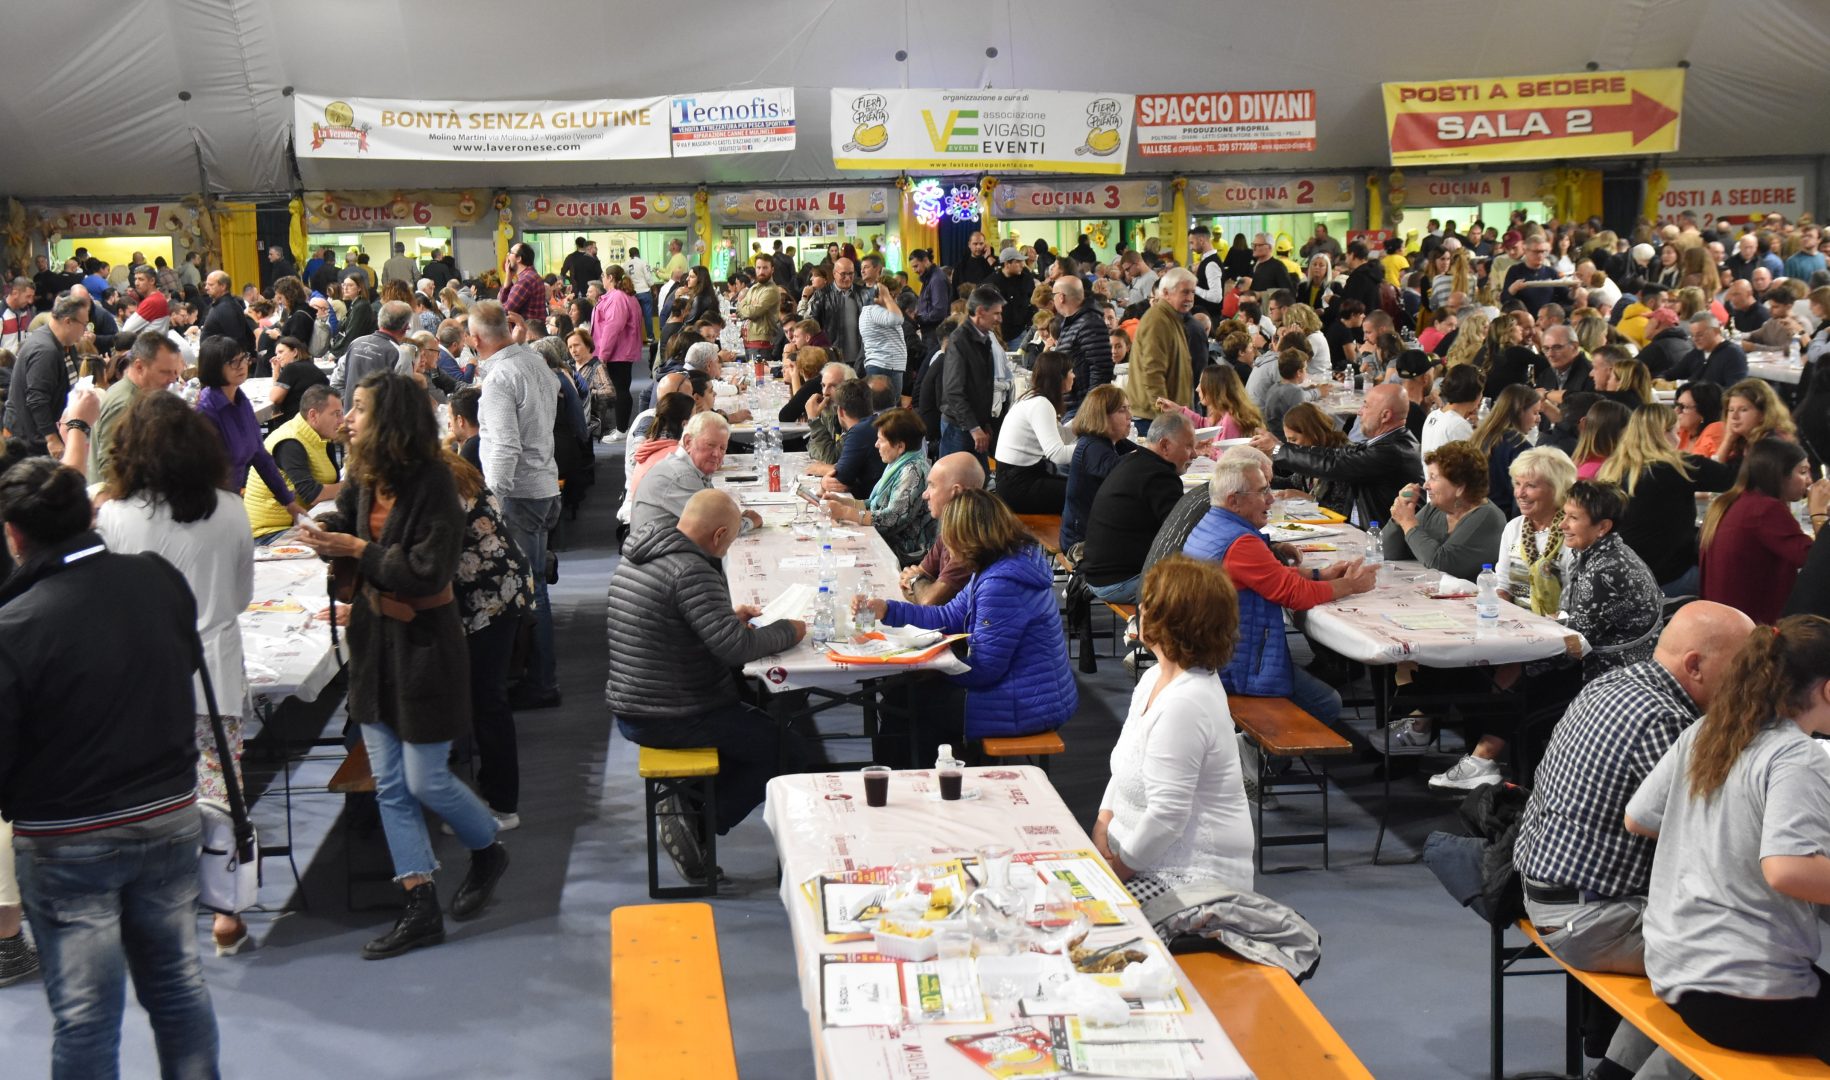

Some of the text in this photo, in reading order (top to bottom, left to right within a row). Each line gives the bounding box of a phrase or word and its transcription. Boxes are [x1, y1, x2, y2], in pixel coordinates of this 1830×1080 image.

[1399, 76, 1626, 104] POSTI A SEDERE
[858, 96, 882, 109] FIERA
[942, 94, 996, 103] organizzazione
[1092, 101, 1116, 113] FIERA
[1141, 92, 1311, 124] SPACCIO DIVANI
[381, 108, 651, 130] BONTÀ SENZA GLUTINE
[856, 110, 886, 123] POLENTA
[983, 110, 1046, 119] associazione
[1091, 115, 1120, 128] POLENTA
[766, 120, 789, 128] SPORTIVA
[983, 123, 1046, 138] VIGASIO
[1182, 126, 1233, 134] PRODUZIONE
[1436, 109, 1593, 141] SALA 2
[329, 129, 361, 138] Veronese
[429, 133, 456, 141] Molino
[458, 133, 487, 141] Martini
[545, 133, 571, 142] Vigasio
[573, 132, 604, 141] (Verona)
[453, 143, 581, 152] www.laveronese.com
[983, 141, 1045, 155] EVENTI
[1142, 144, 1172, 154] VALLESE
[1178, 145, 1202, 153] OPPEANO
[1206, 144, 1217, 152] TEL.
[1225, 186, 1288, 201] CUCINA
[1296, 180, 1315, 204] 2
[1429, 176, 1511, 198] CUCINA 1
[754, 197, 820, 212] CUCINA
[828, 191, 846, 214] 4
[1031, 185, 1120, 209] CUCINA 3
[1711, 190, 1722, 206] A
[1728, 187, 1796, 206] SEDERE
[338, 201, 432, 224] CUCIN 6
[556, 202, 621, 217] CUCINA
[629, 195, 648, 220] 5
[143, 205, 160, 230] 7
